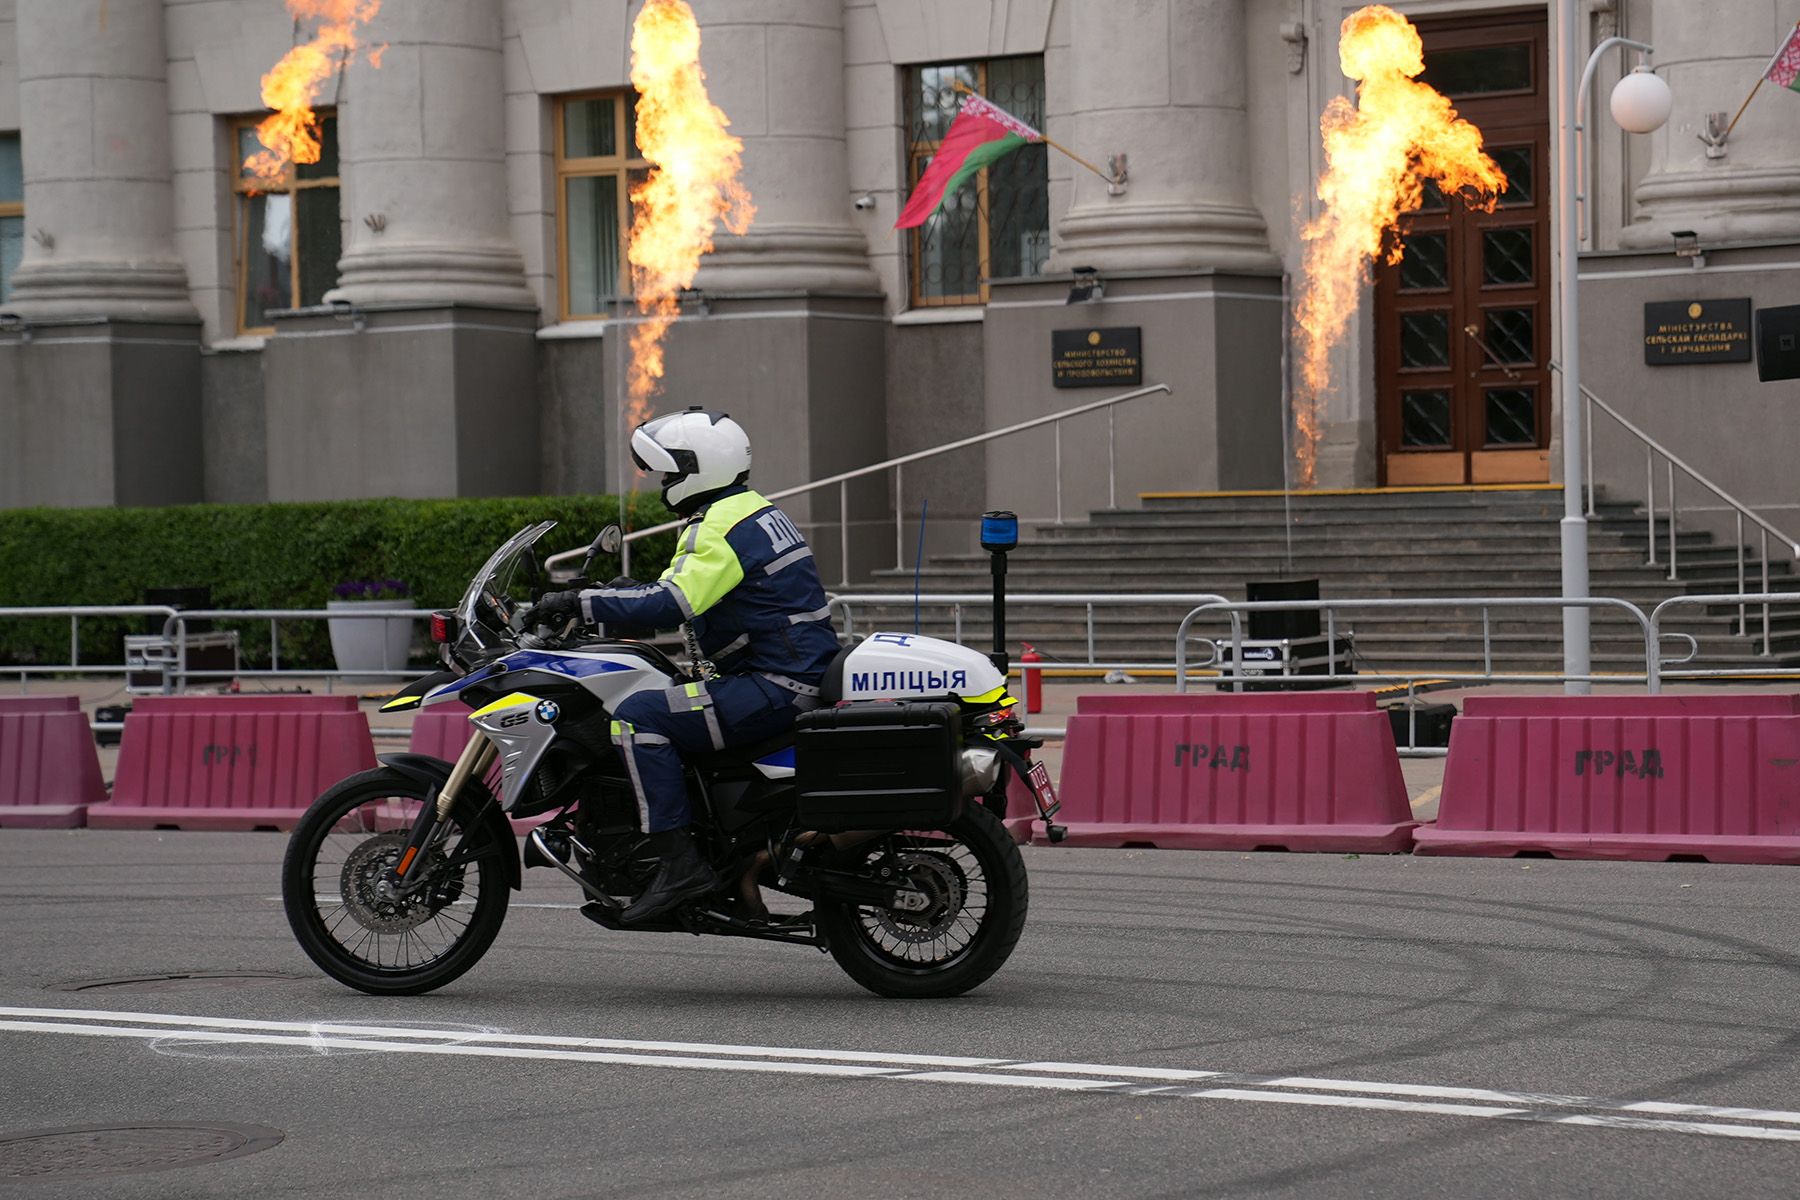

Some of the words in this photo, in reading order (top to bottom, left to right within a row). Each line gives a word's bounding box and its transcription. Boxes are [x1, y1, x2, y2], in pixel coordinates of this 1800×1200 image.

[1658, 322, 1733, 333] МІНІСТЭРСТВА
[1064, 348, 1127, 358] МИНИСТЕРСТВО
[852, 670, 967, 693] МІЛІЦЫЯ
[500, 711, 530, 728] GS
[1174, 744, 1250, 772] ГРАД
[1575, 748, 1665, 779] ГРАД
